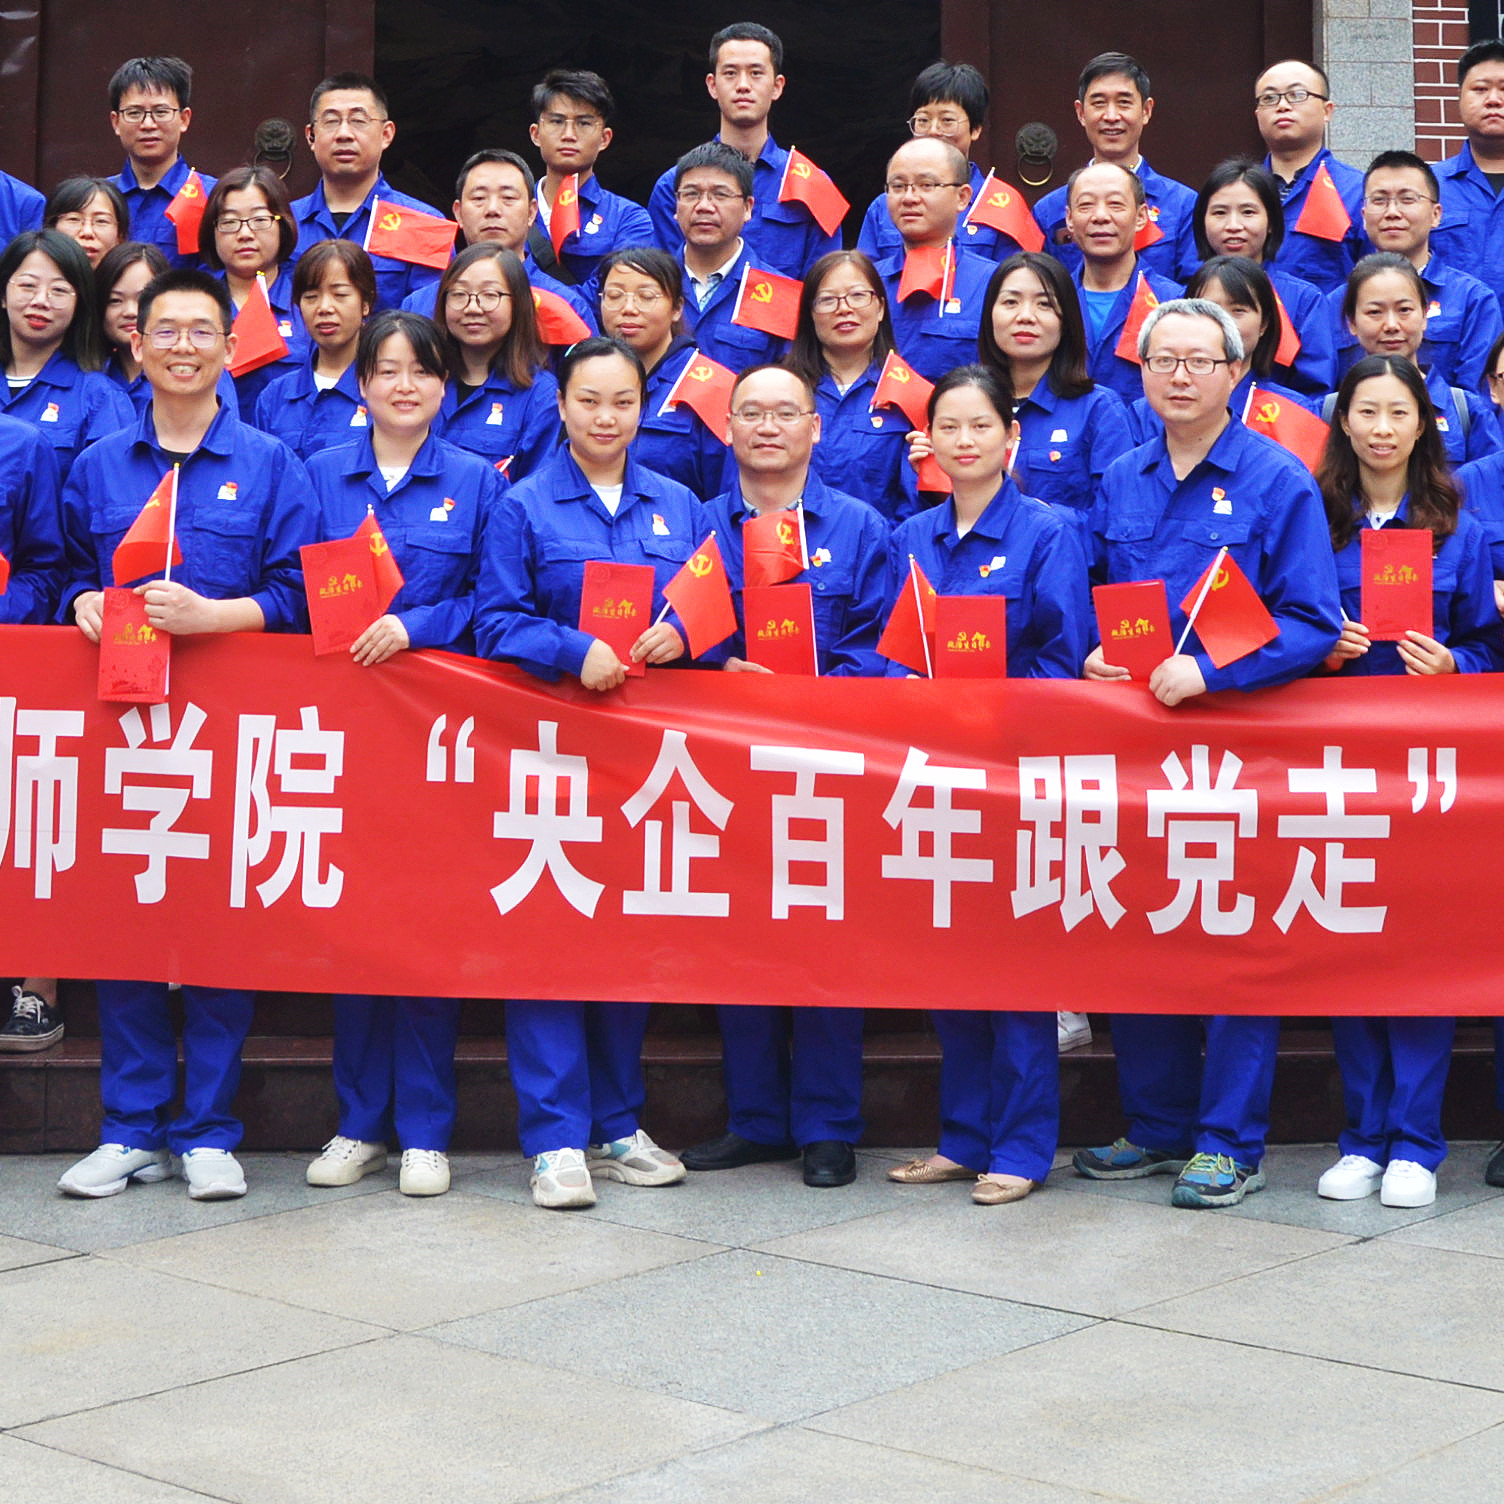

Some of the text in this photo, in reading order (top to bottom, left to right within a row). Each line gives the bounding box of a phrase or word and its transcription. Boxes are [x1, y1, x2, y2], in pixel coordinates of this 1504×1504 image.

[426, 712, 1458, 936] “央企百年跟党走”
